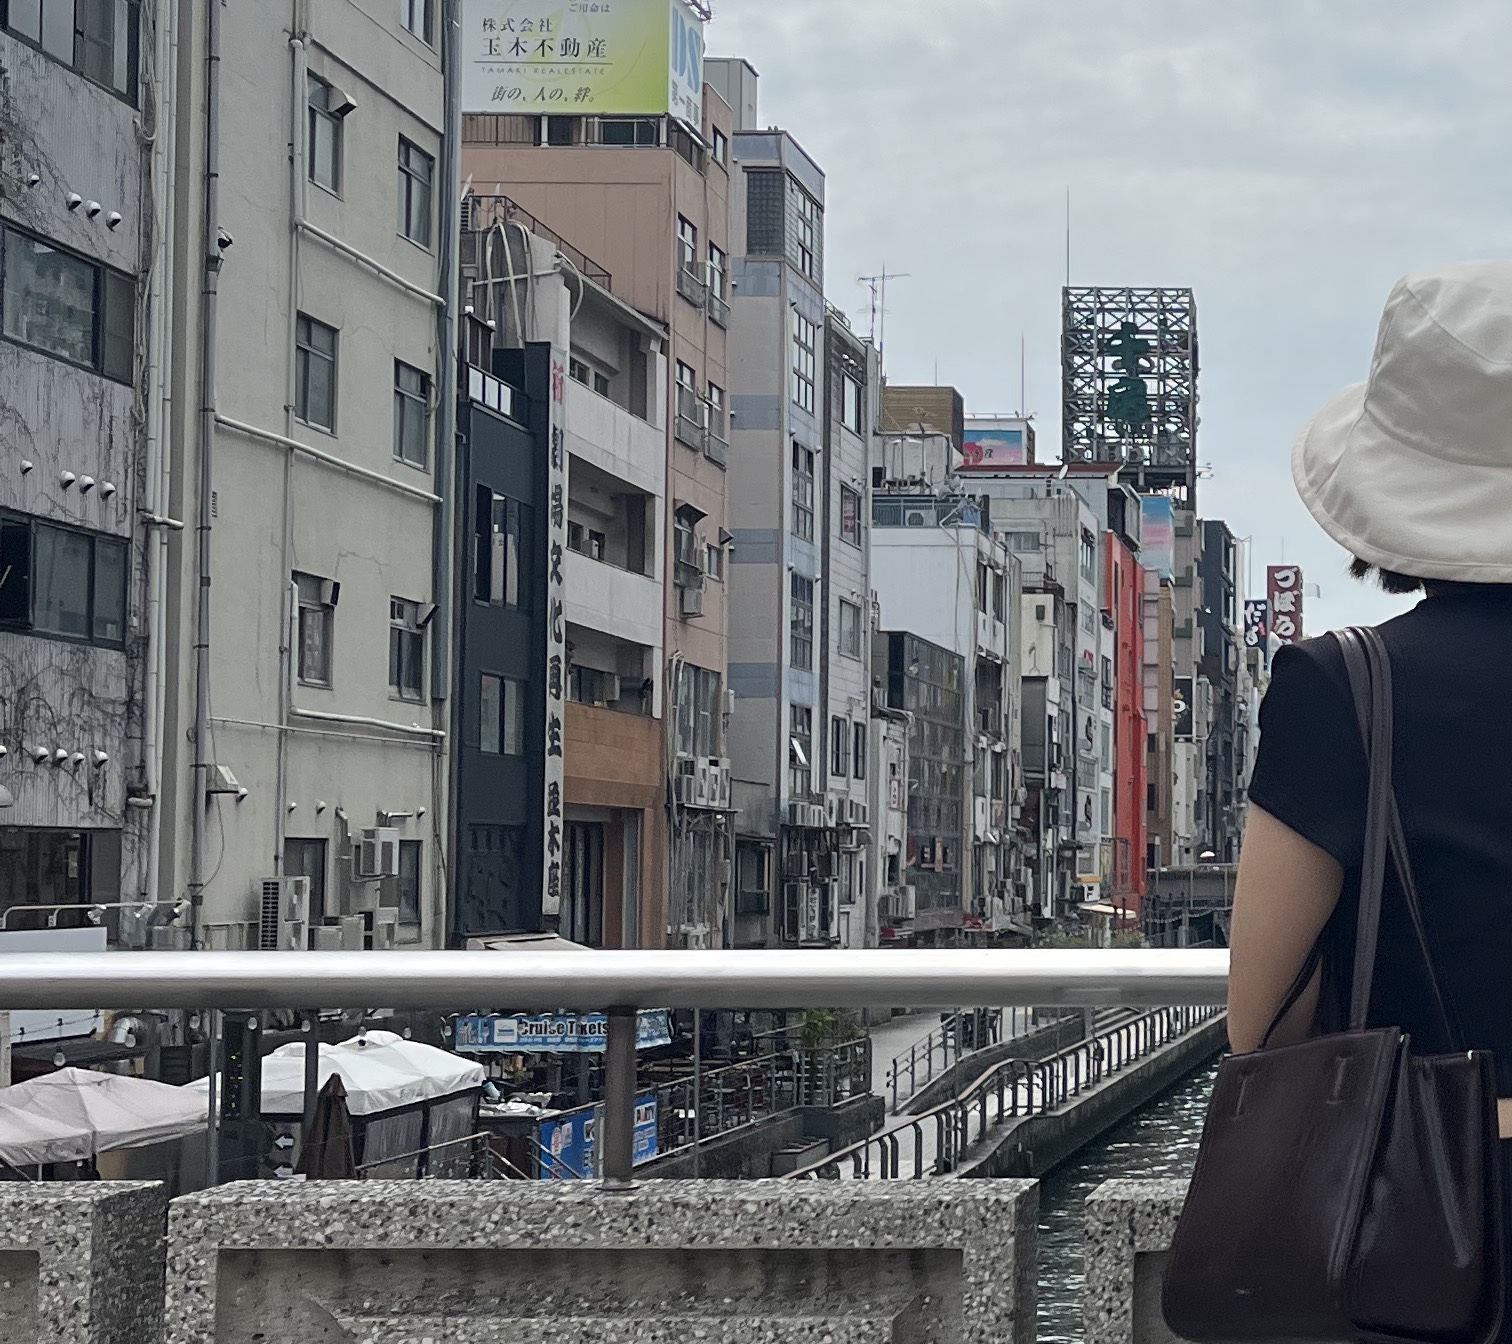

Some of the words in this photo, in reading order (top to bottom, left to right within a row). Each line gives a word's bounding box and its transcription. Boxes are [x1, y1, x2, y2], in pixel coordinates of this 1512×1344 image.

[482, 17, 553, 33] 株式会社
[482, 36, 607, 58] 玉木不動産
[1273, 567, 1300, 644] づぼら
